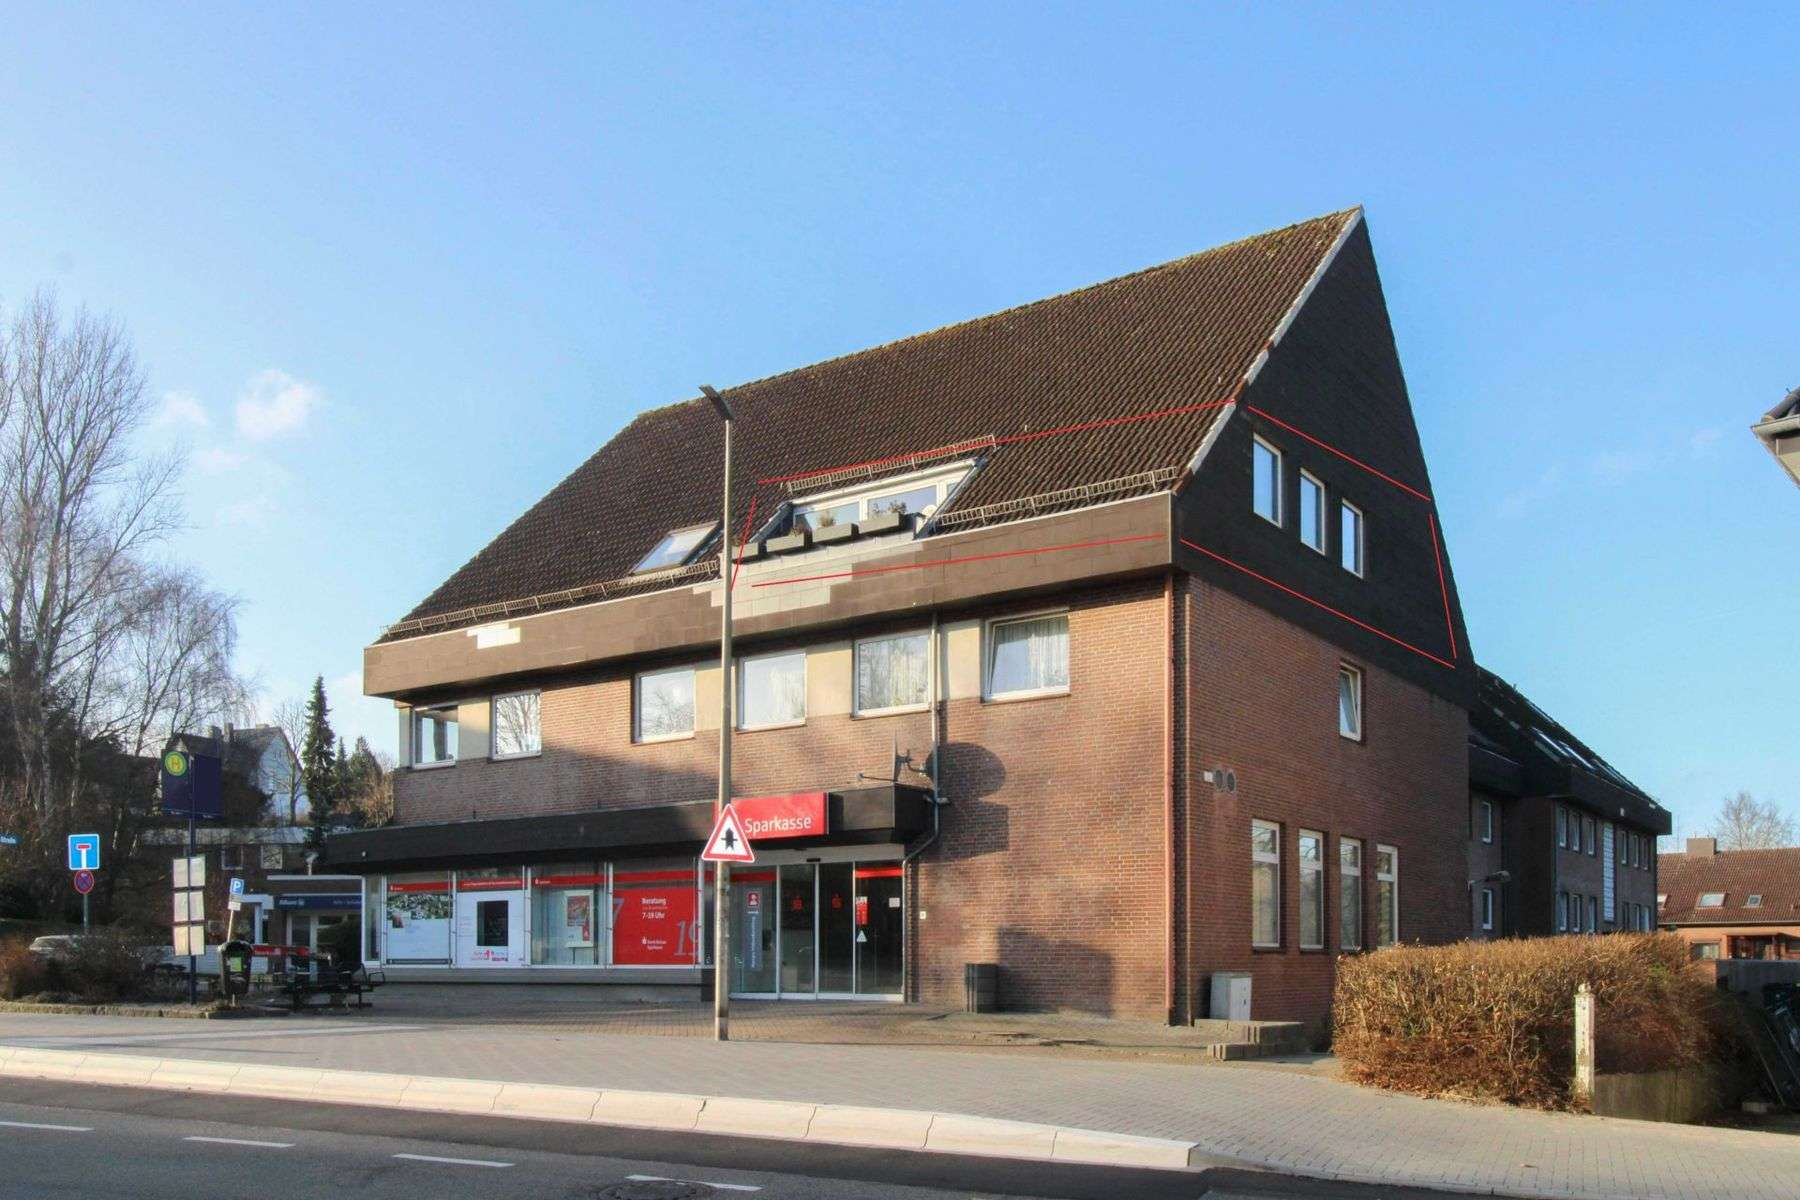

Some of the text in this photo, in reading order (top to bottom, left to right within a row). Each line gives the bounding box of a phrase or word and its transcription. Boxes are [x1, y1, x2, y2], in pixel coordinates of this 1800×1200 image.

[744, 815, 812, 836] Sparkasse
[232, 880, 242, 892] P
[641, 898, 666, 906] Beratung
